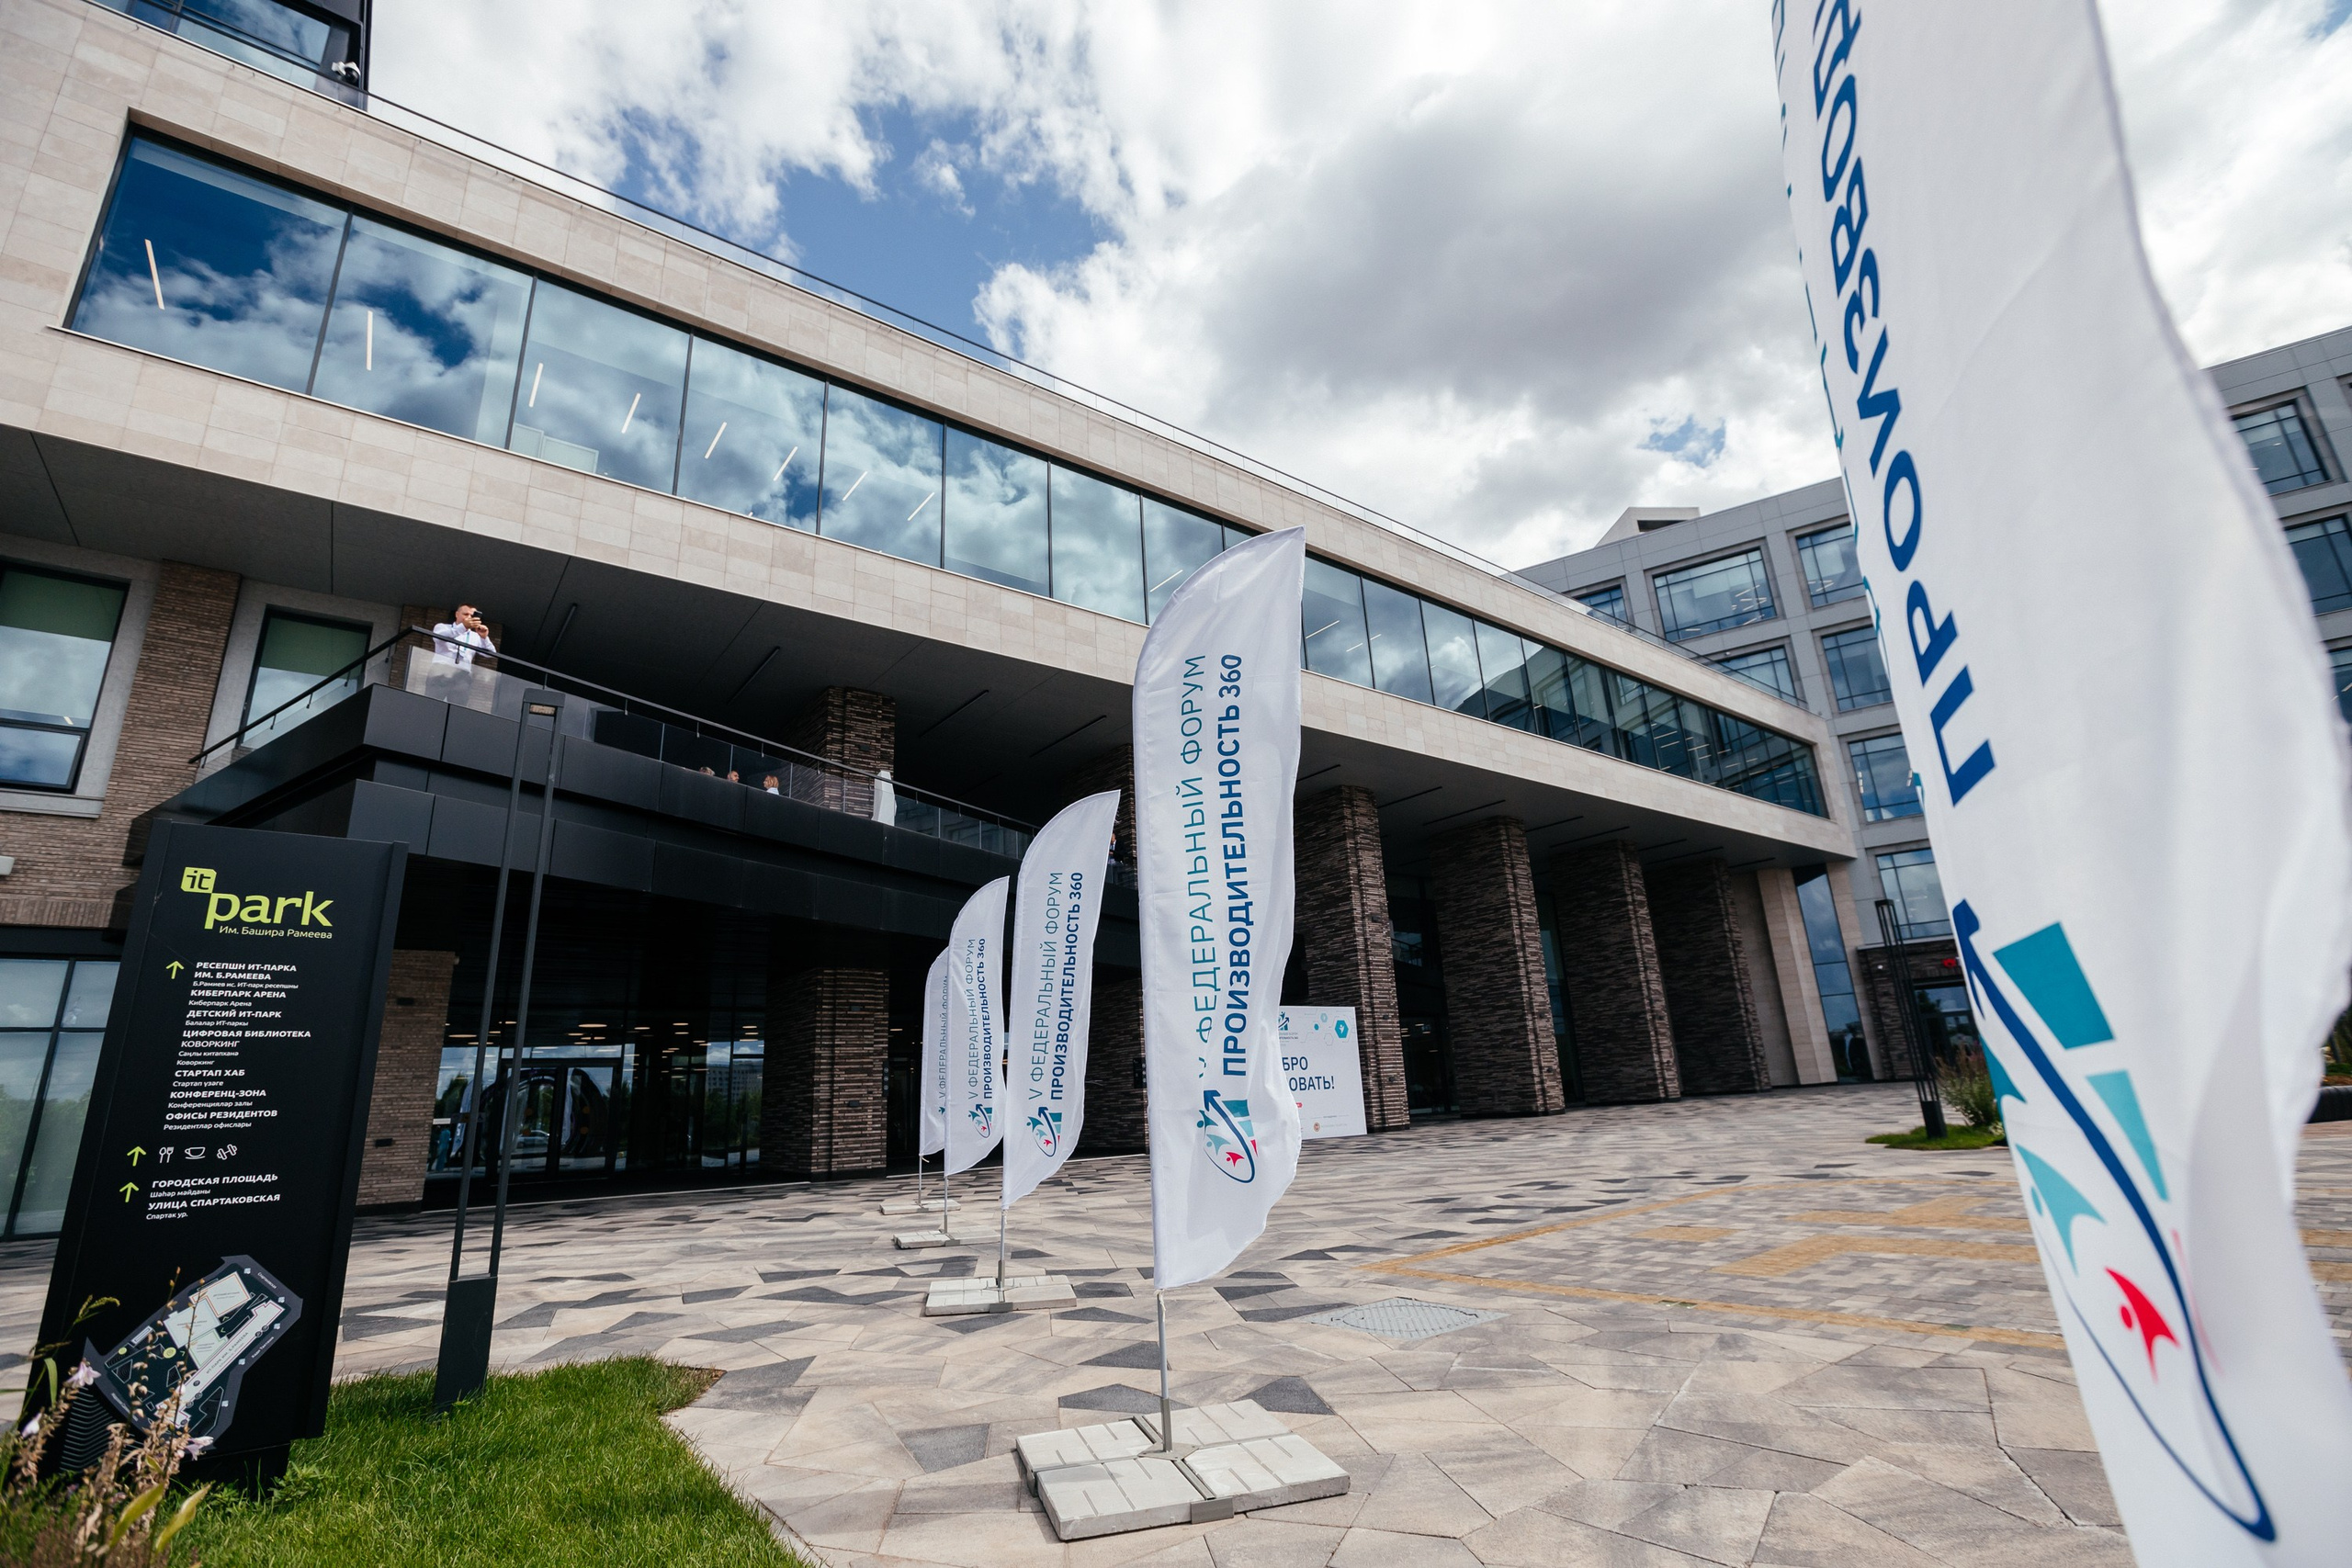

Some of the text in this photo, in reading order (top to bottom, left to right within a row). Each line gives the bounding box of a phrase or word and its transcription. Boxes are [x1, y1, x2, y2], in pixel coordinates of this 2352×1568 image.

[1813, 0, 1996, 807] ПРОИЗВОД
[1176, 655, 1220, 1043] ФЕДЕРАЛЬНЫЙ ФОРУМ
[1217, 654, 1254, 1076] ПРОИЗВОДИТЕЛЬНОСТЬ 360
[187, 870, 211, 890] it
[204, 891, 334, 930] park
[219, 925, 333, 939] Им. Башира Рамеева
[196, 962, 297, 972] РЕСЕПШН ИТ-ПАРКА
[216, 972, 272, 980] Б.РАМЕЕВА
[1029, 872, 1063, 1100] V ФЕДЕРАЛЬНЫЙ ФОРУМ
[1050, 873, 1083, 1100] ПРОИЗВОДИТЕЛЬНОСТЬ 360
[187, 1010, 236, 1018] ДЕТСКИЙ
[965, 939, 979, 1100] V ФЕДЕРАЛЬНЫЙ ФОРУМ
[977, 938, 992, 1100] ПРОИЗВОДИТЕЛЬНОСТЬ 360
[182, 1030, 243, 1038] ЦИФРОВАЯ
[180, 1040, 240, 1048] КОВОРКИНГ
[175, 1069, 222, 1077] СТАРТАП
[170, 1089, 266, 1099] КОНФЕРЕНЦ-ЗОНА
[165, 1110, 277, 1121] ОФИСЫ РЕЗИДЕНТОВ
[164, 1122, 213, 1131] Резидентлар
[152, 1173, 278, 1189] ГОРОДСКАЯ ПЛОЩАДЬ
[148, 1194, 281, 1210] УЛИЦА СПАРТАКОВСКАЯ
